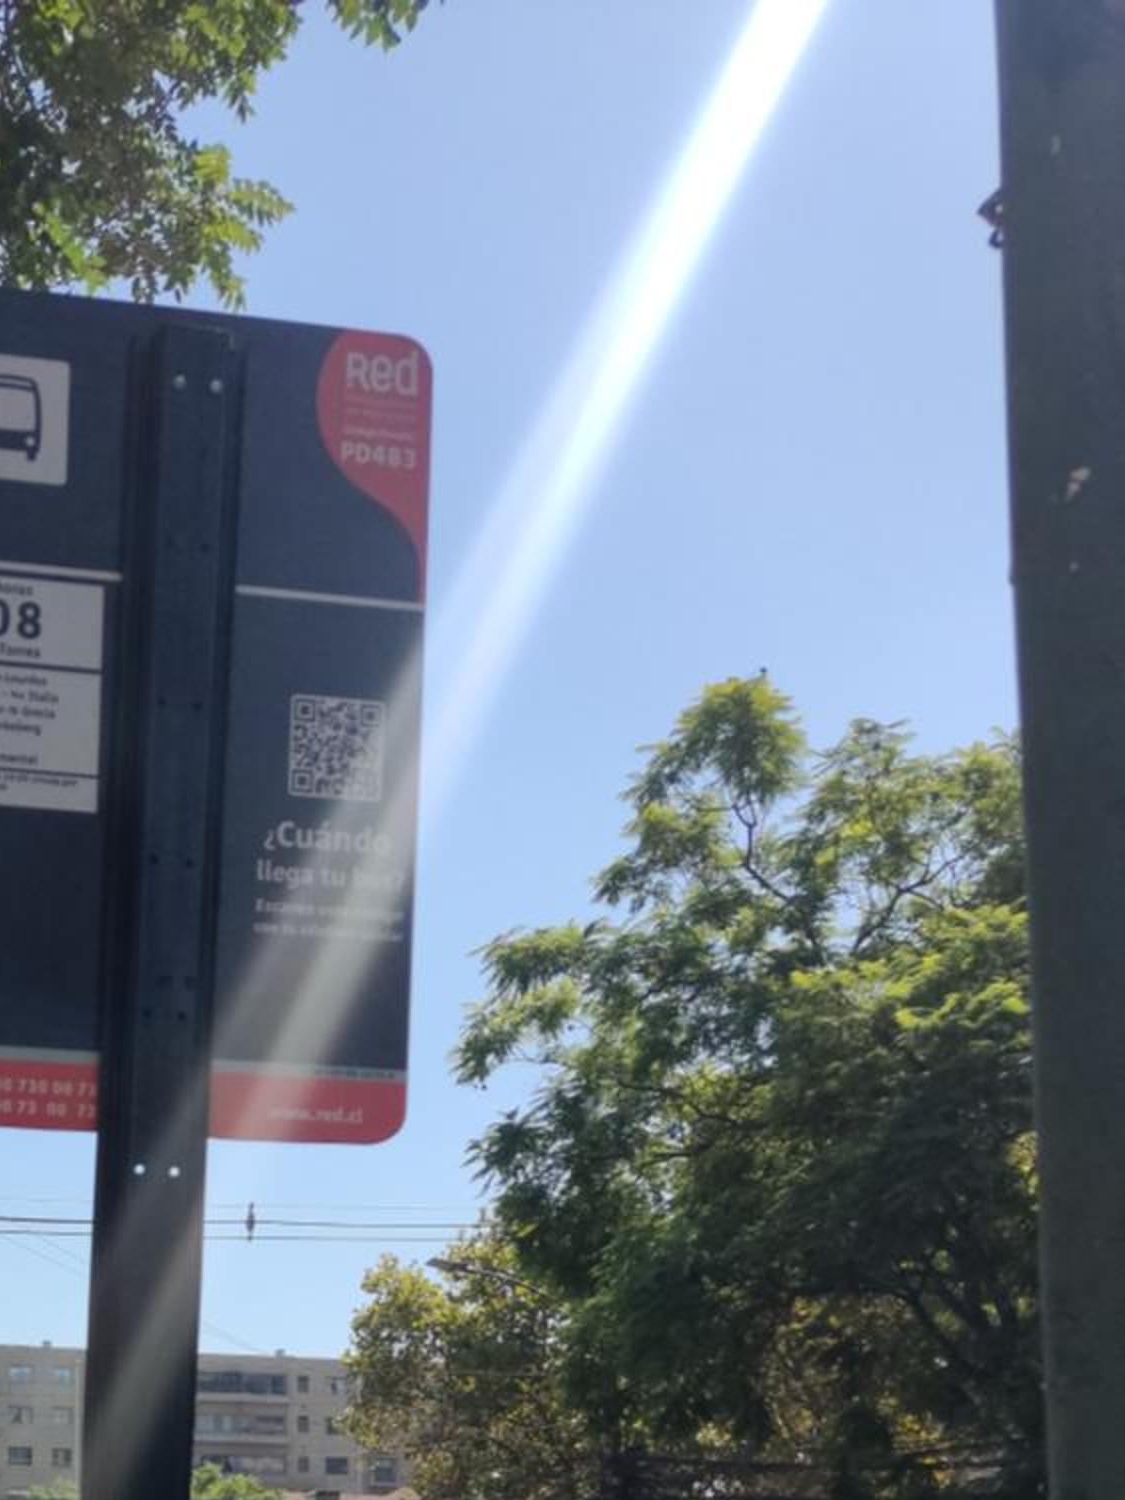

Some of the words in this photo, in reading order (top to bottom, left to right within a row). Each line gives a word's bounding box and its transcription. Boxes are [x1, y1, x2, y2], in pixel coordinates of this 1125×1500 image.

[346, 350, 418, 399] Red
[263, 820, 392, 856] ¿Cuándo
[255, 858, 315, 890] llega
[320, 867, 346, 888] tu
